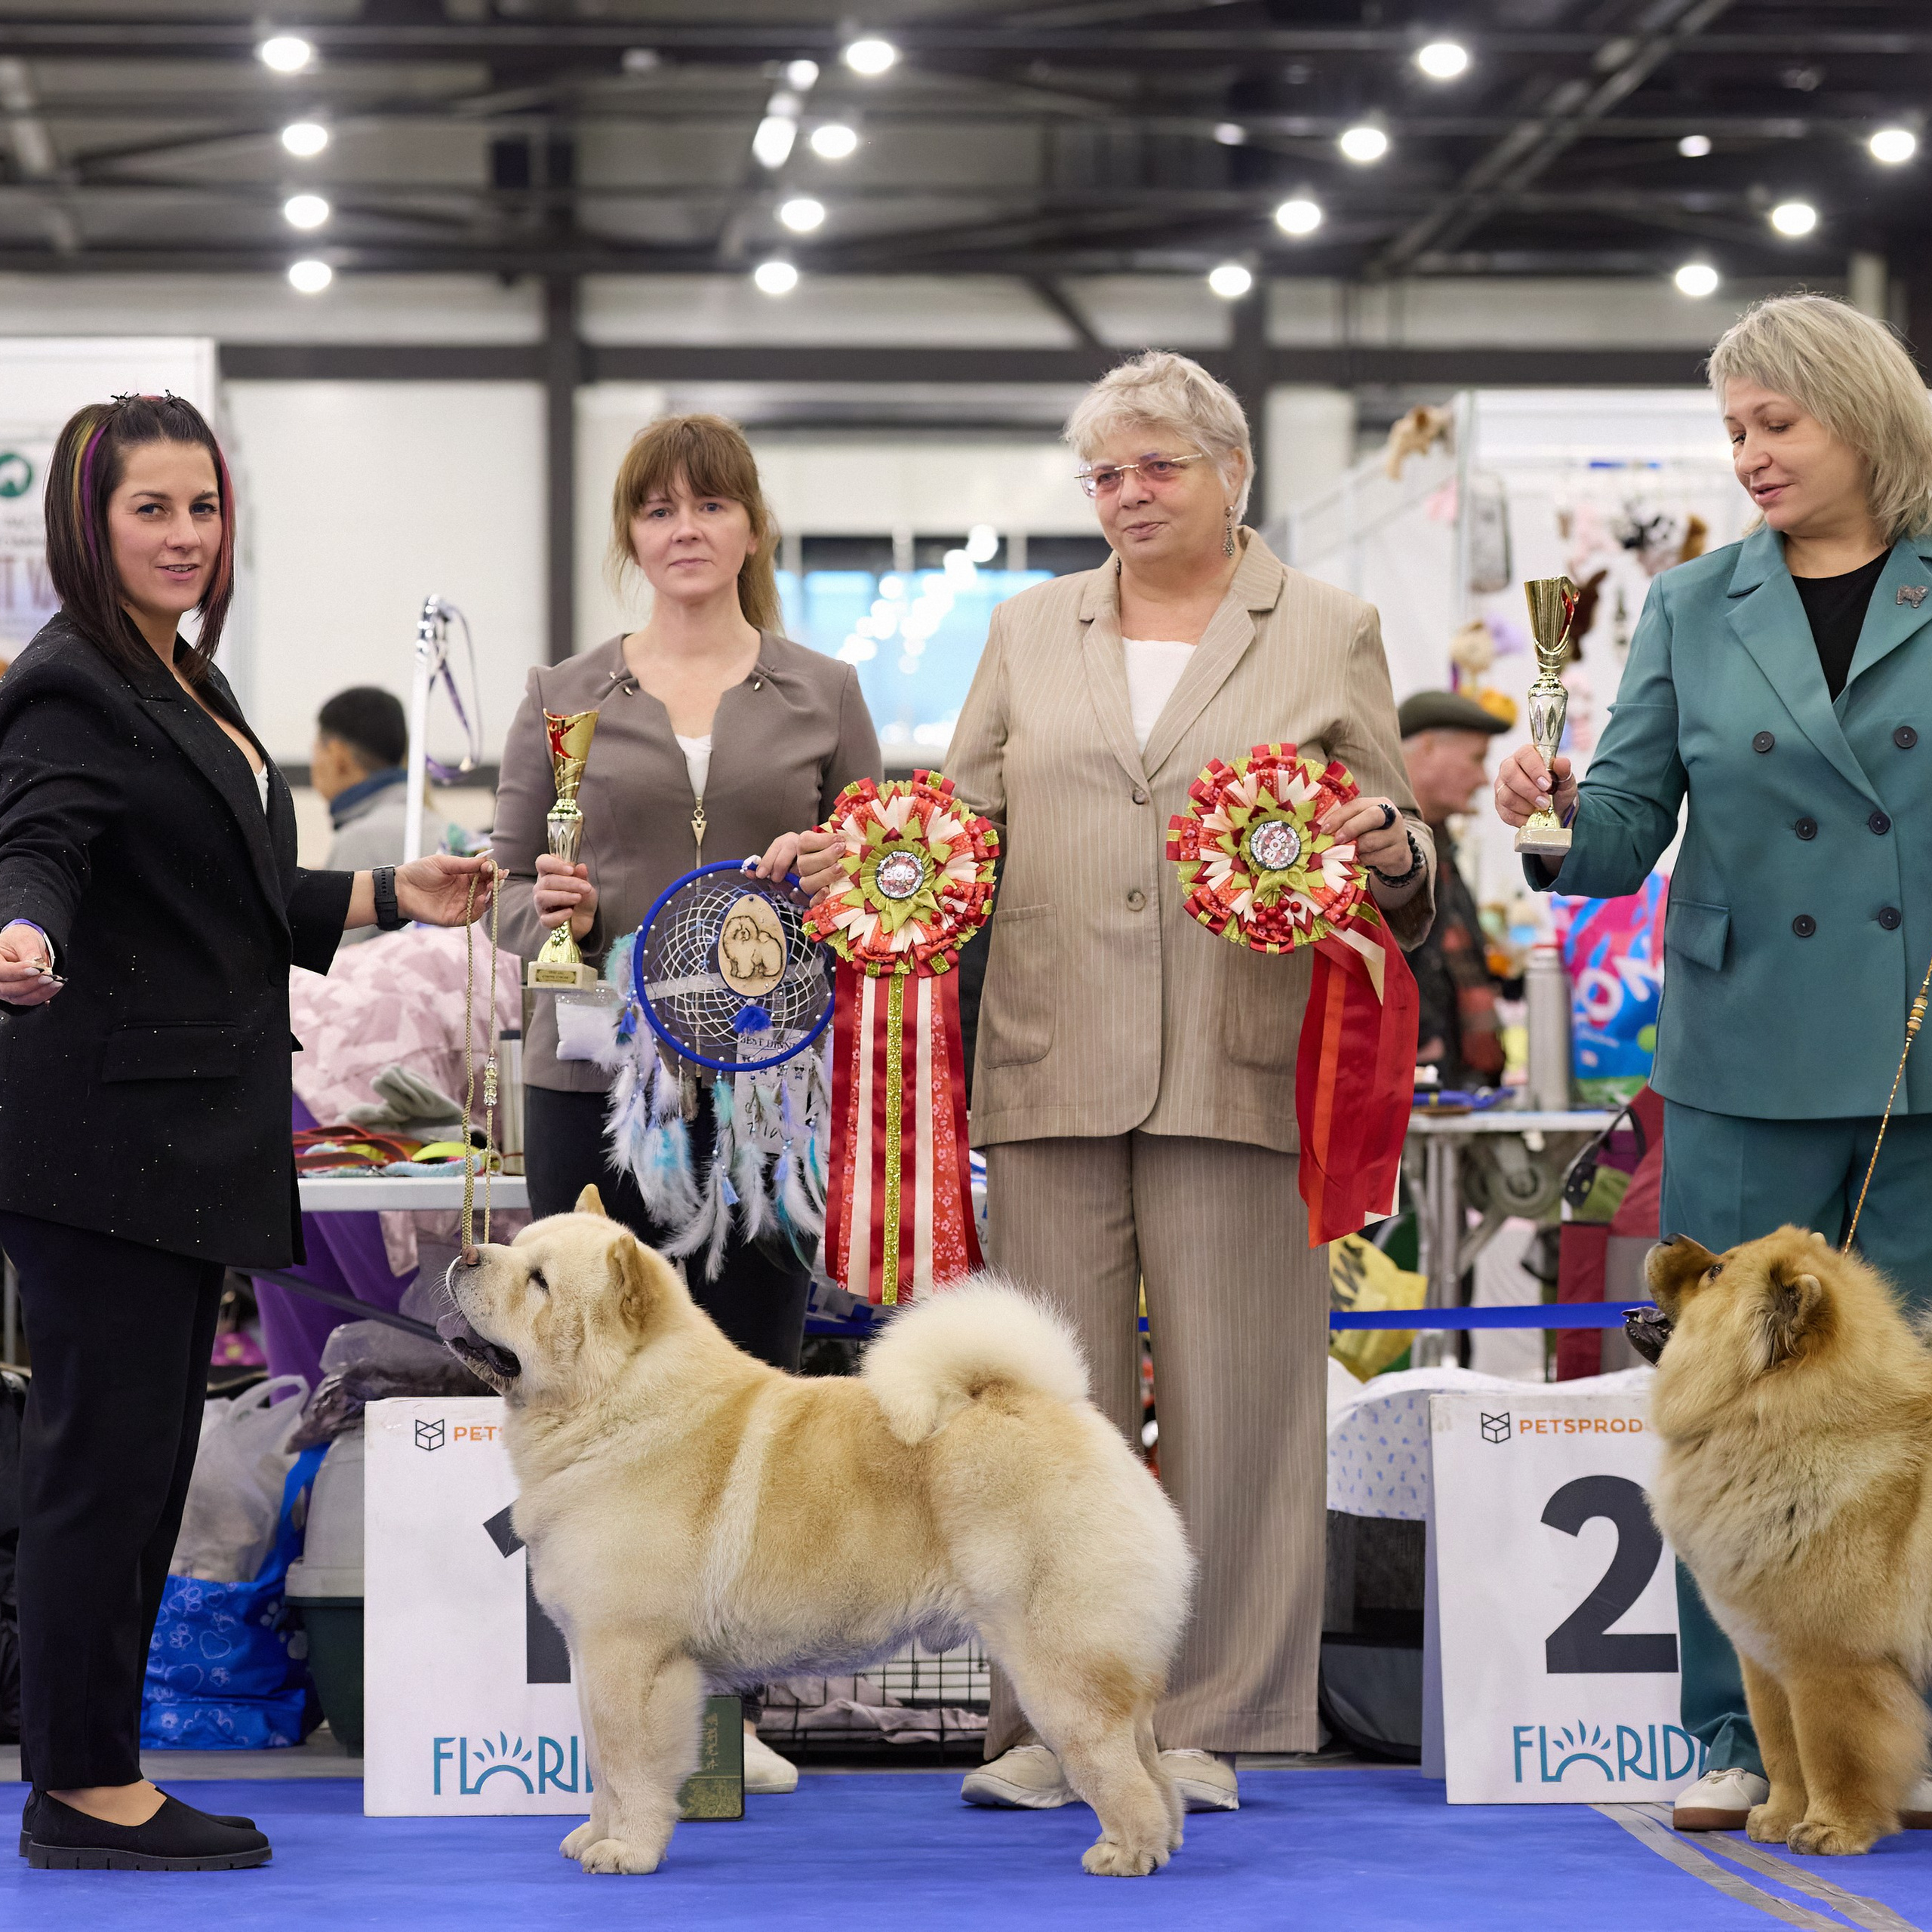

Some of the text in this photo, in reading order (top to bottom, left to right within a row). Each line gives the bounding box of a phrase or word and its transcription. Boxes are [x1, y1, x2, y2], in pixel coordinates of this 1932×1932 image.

[883, 866, 916, 881] BOB
[454, 1426, 503, 1441] PET
[1519, 1419, 1644, 1434] PETSPROD
[1540, 1475, 1679, 1674] 2
[483, 1498, 571, 1684] 1
